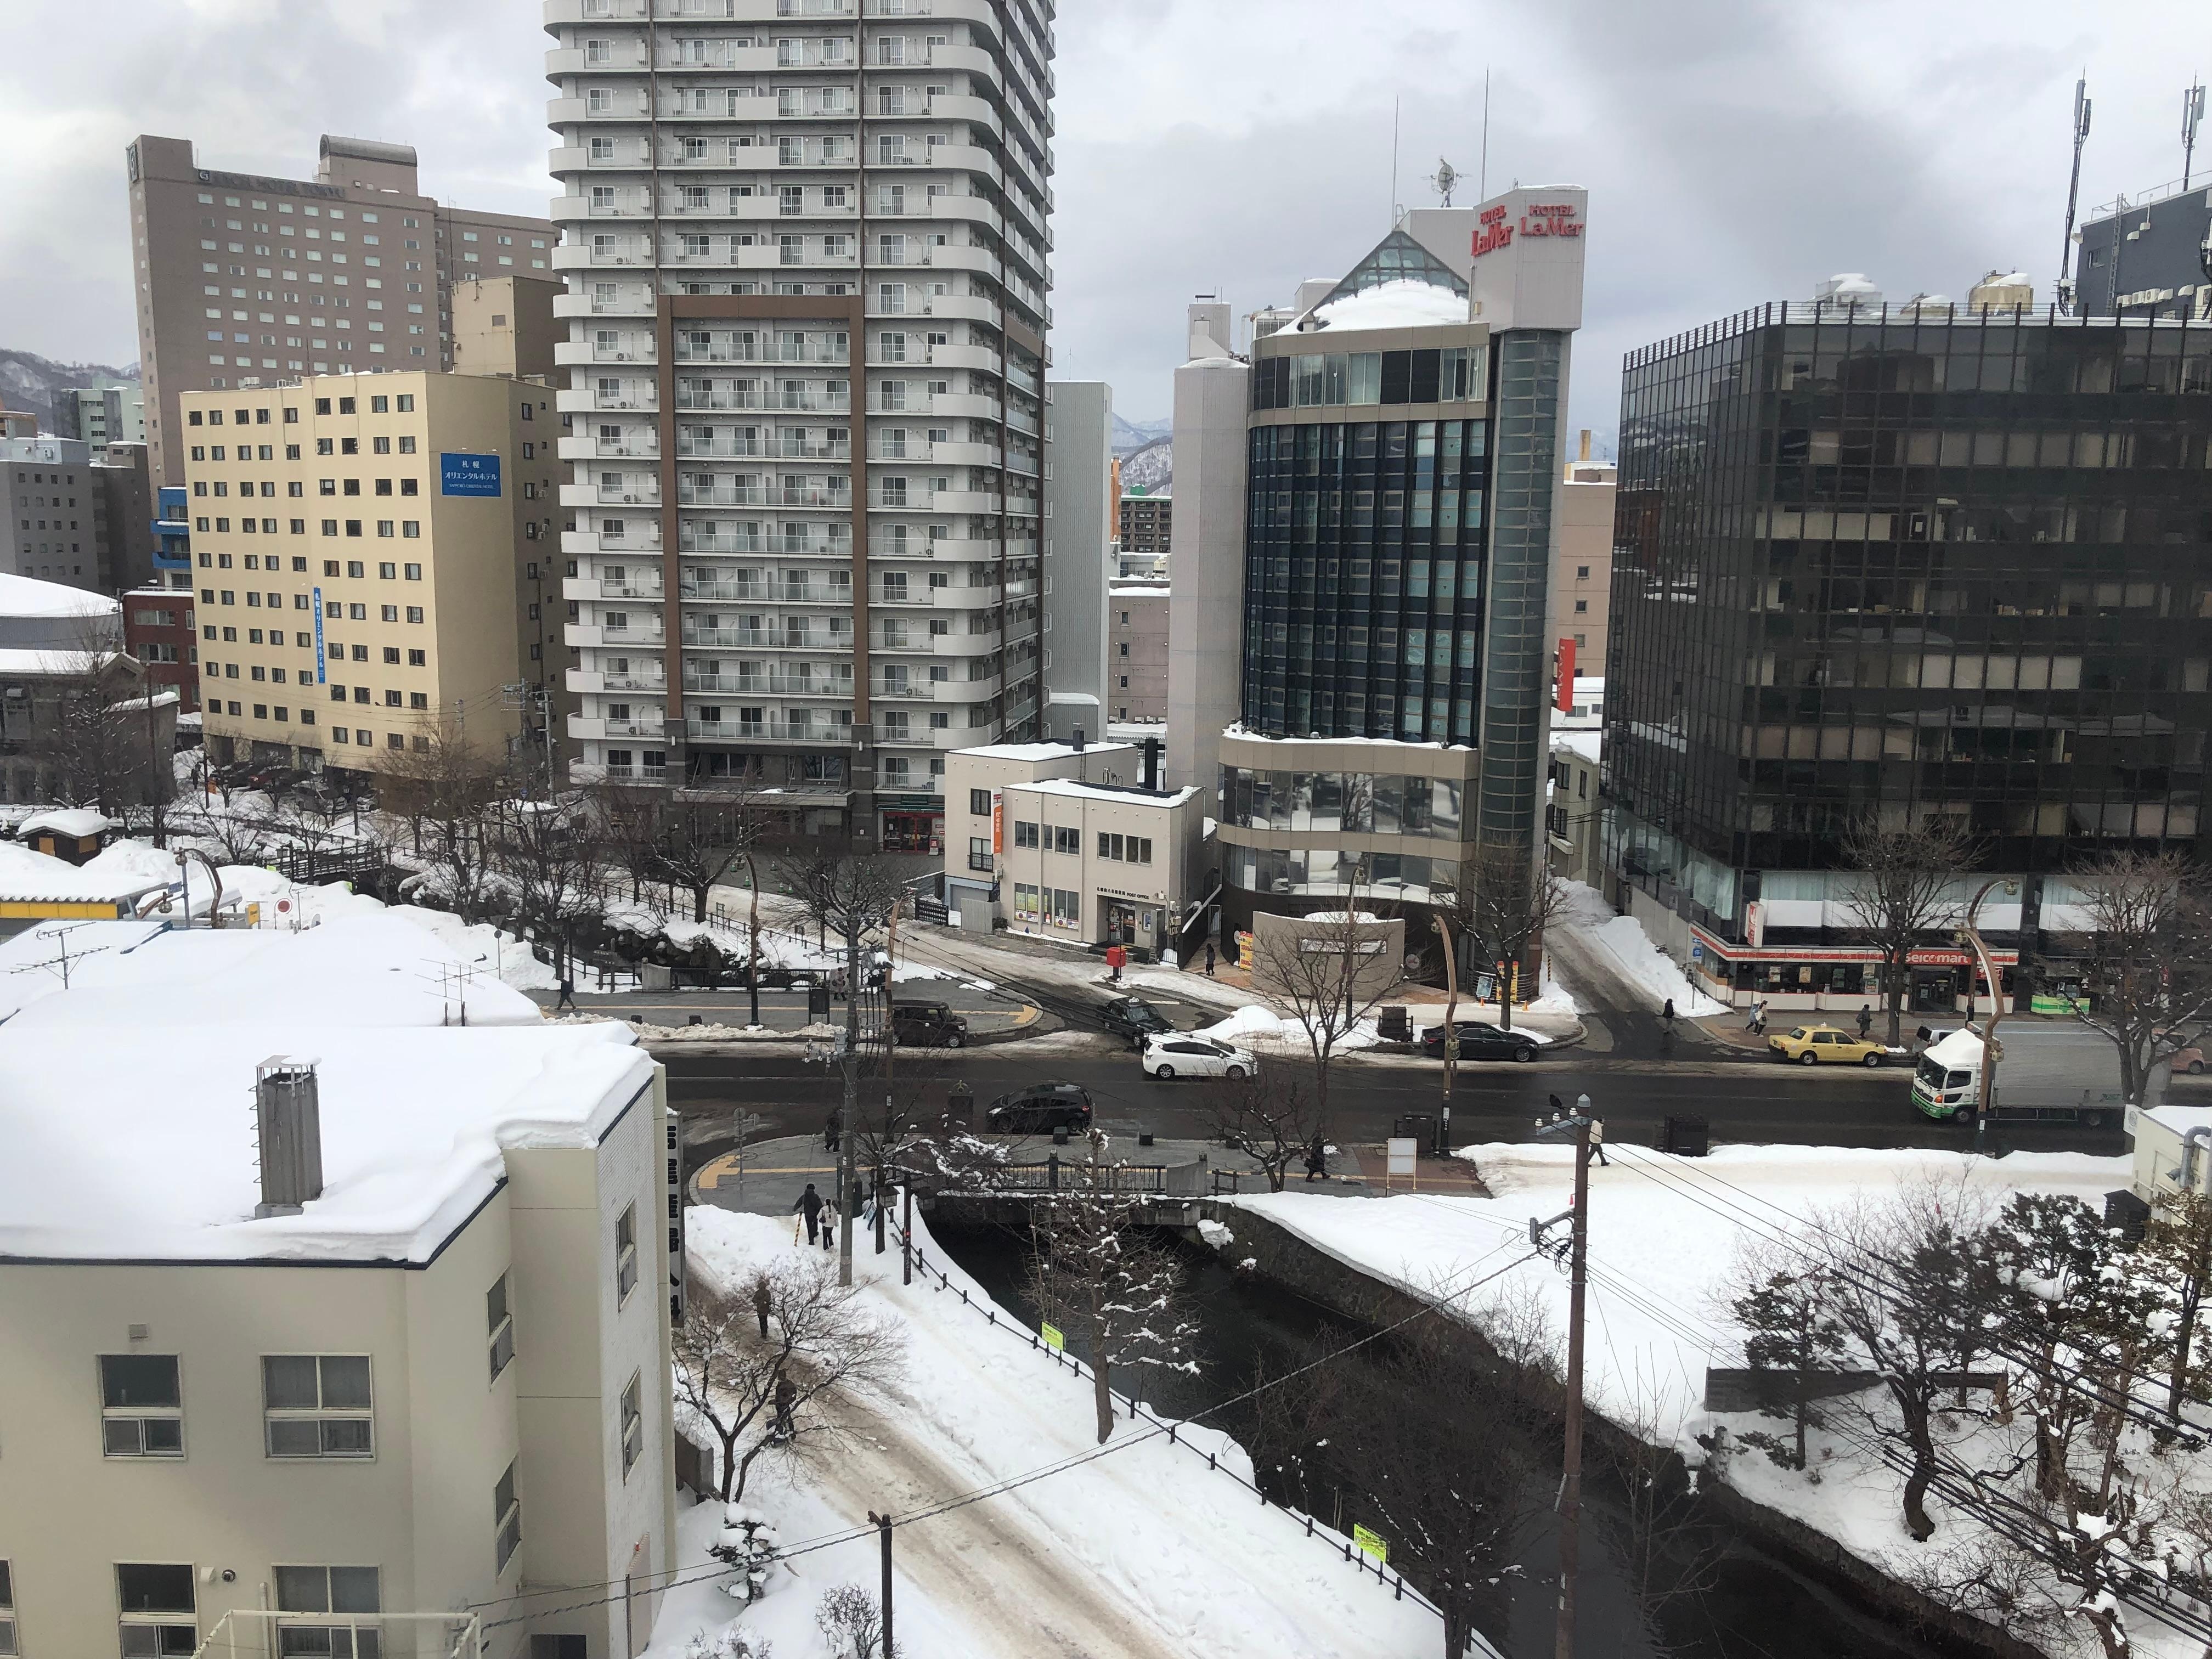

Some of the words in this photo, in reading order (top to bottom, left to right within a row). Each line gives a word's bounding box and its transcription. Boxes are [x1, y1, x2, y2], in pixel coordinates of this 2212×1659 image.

[1529, 205, 1576, 216] HOTEL
[445, 471, 497, 480] オリエンタルホテル
